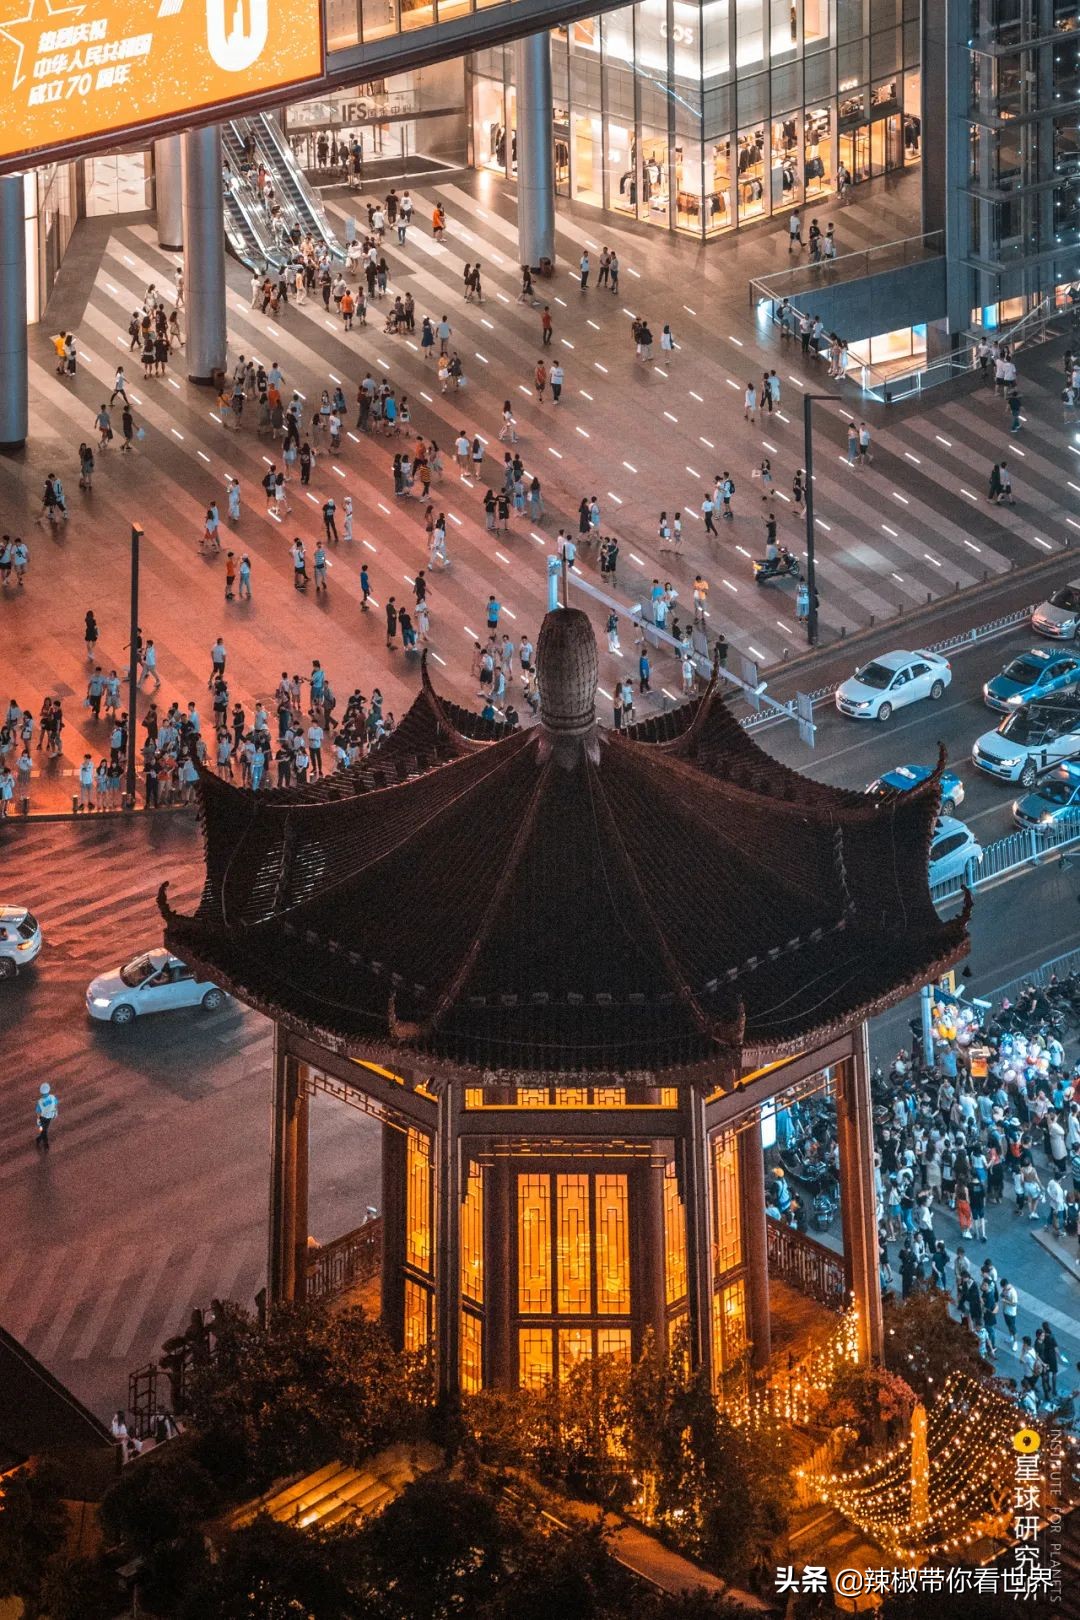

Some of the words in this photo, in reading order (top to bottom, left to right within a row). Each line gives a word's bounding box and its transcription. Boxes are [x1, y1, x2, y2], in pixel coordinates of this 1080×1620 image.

[33, 32, 153, 78] 中华人民共和国
[65, 72, 92, 99] 70
[342, 102, 367, 121] IFS
